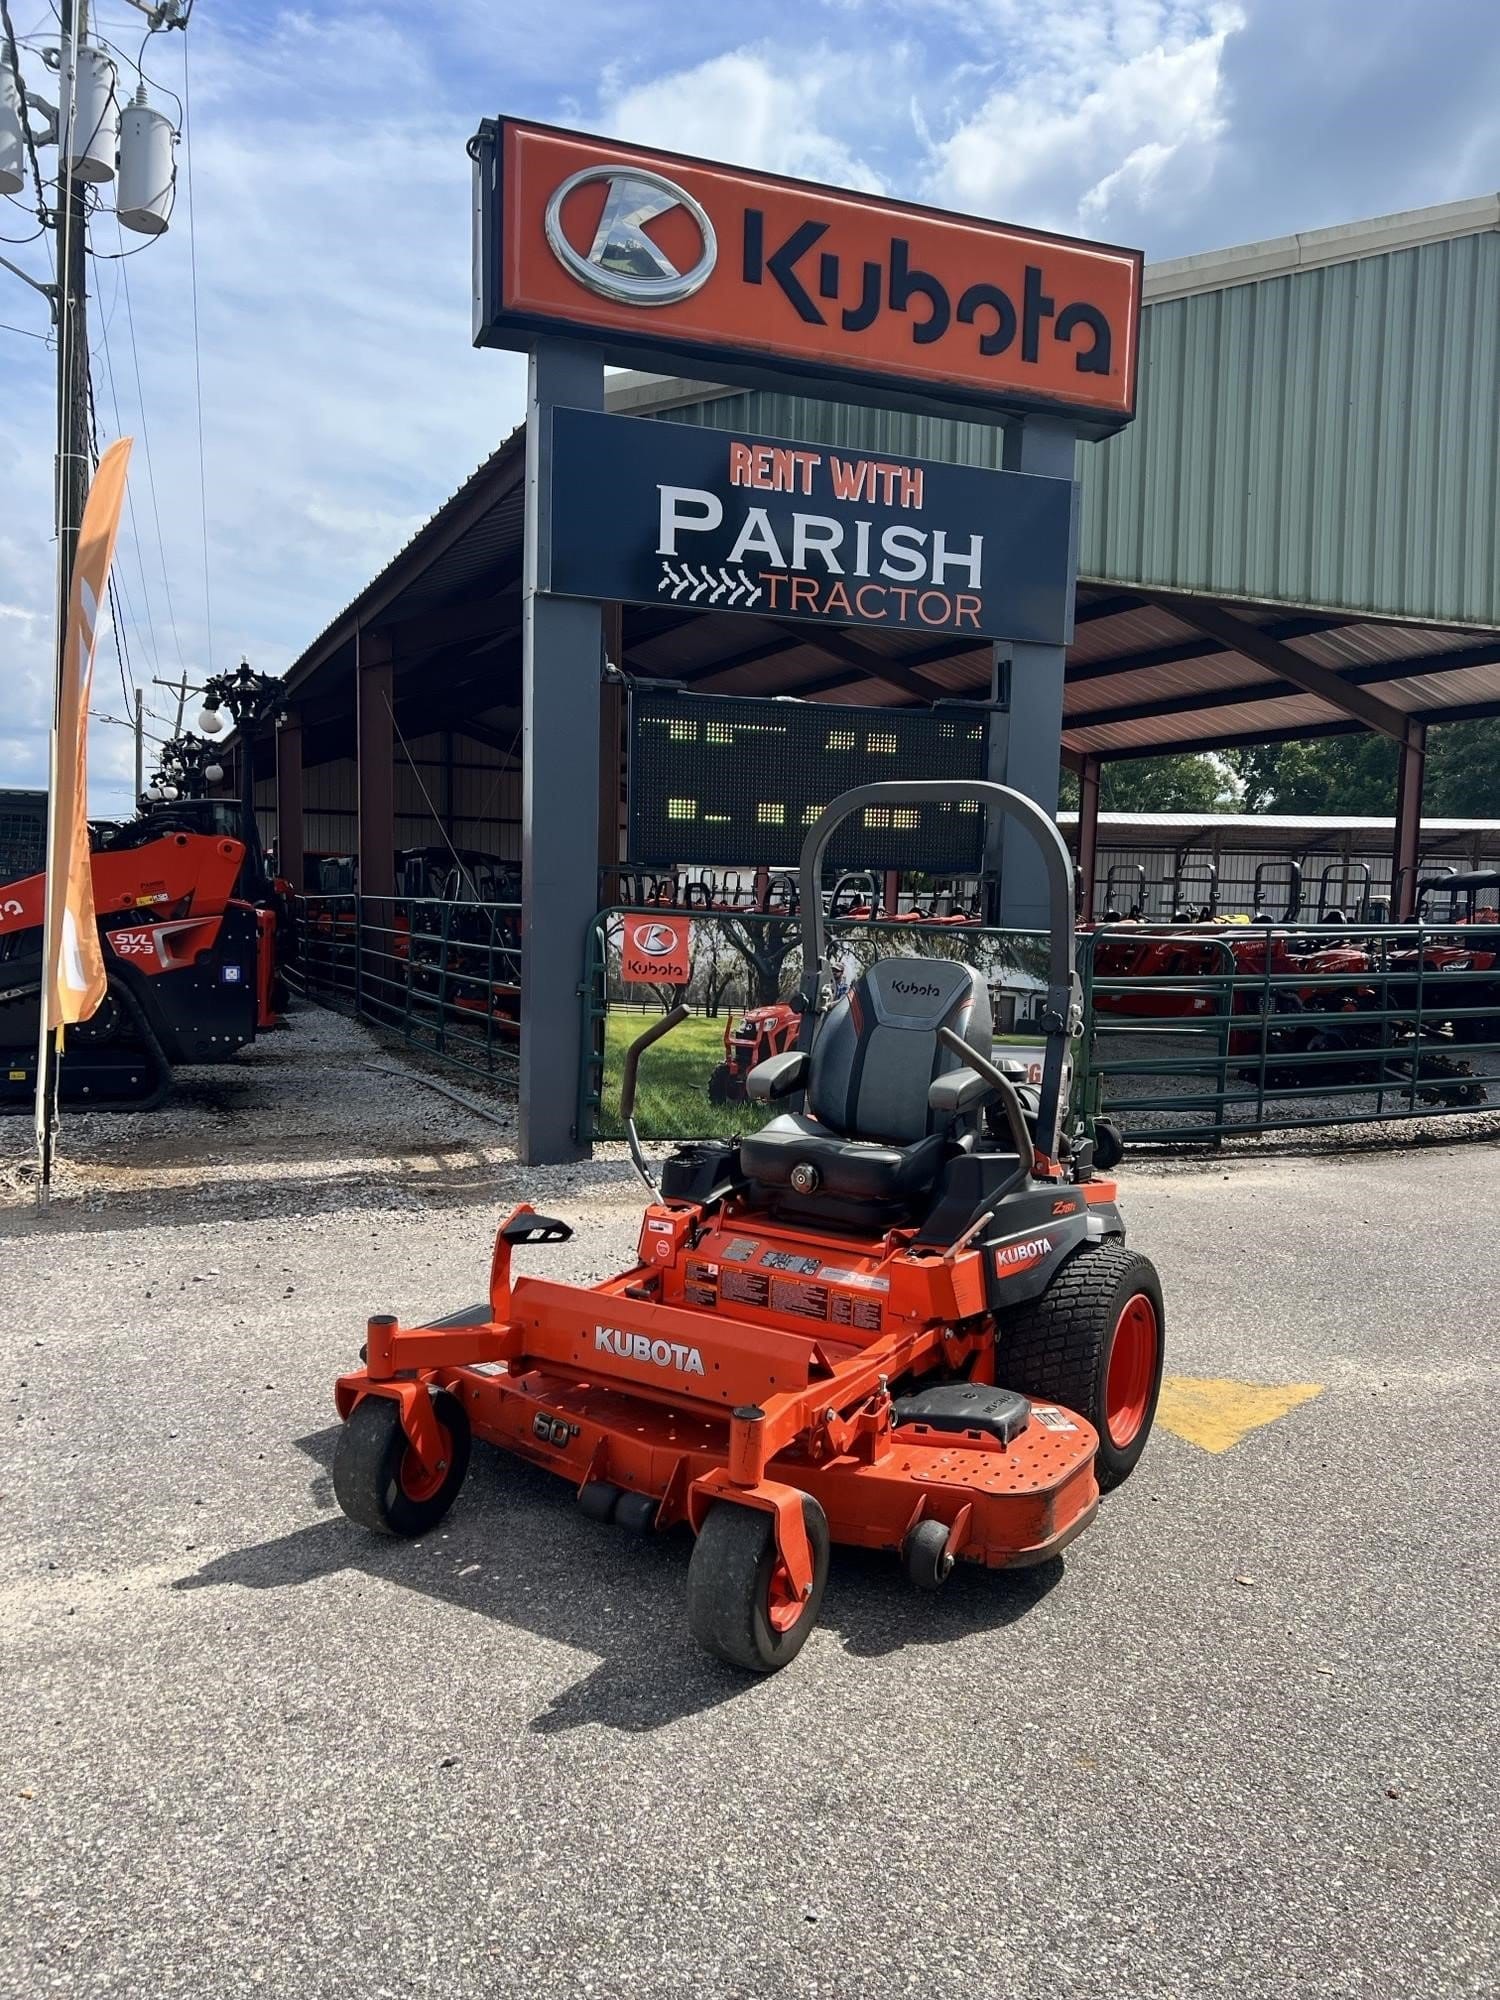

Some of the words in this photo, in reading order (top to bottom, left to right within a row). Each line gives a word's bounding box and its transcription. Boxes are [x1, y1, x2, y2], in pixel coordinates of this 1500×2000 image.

[742, 207, 1112, 376] Kubota
[729, 441, 821, 496] RENT
[830, 455, 924, 510] WITH
[655, 484, 984, 589] PARISH
[758, 571, 983, 629] TRACTOR
[114, 933, 153, 945] SVL
[119, 944, 154, 955] 97-3
[627, 959, 684, 977] Kubota
[891, 979, 941, 997] Kubota
[996, 1238, 1053, 1266] KUBOTA
[594, 1325, 706, 1377] KUBOTA
[533, 1411, 581, 1449] 60"
